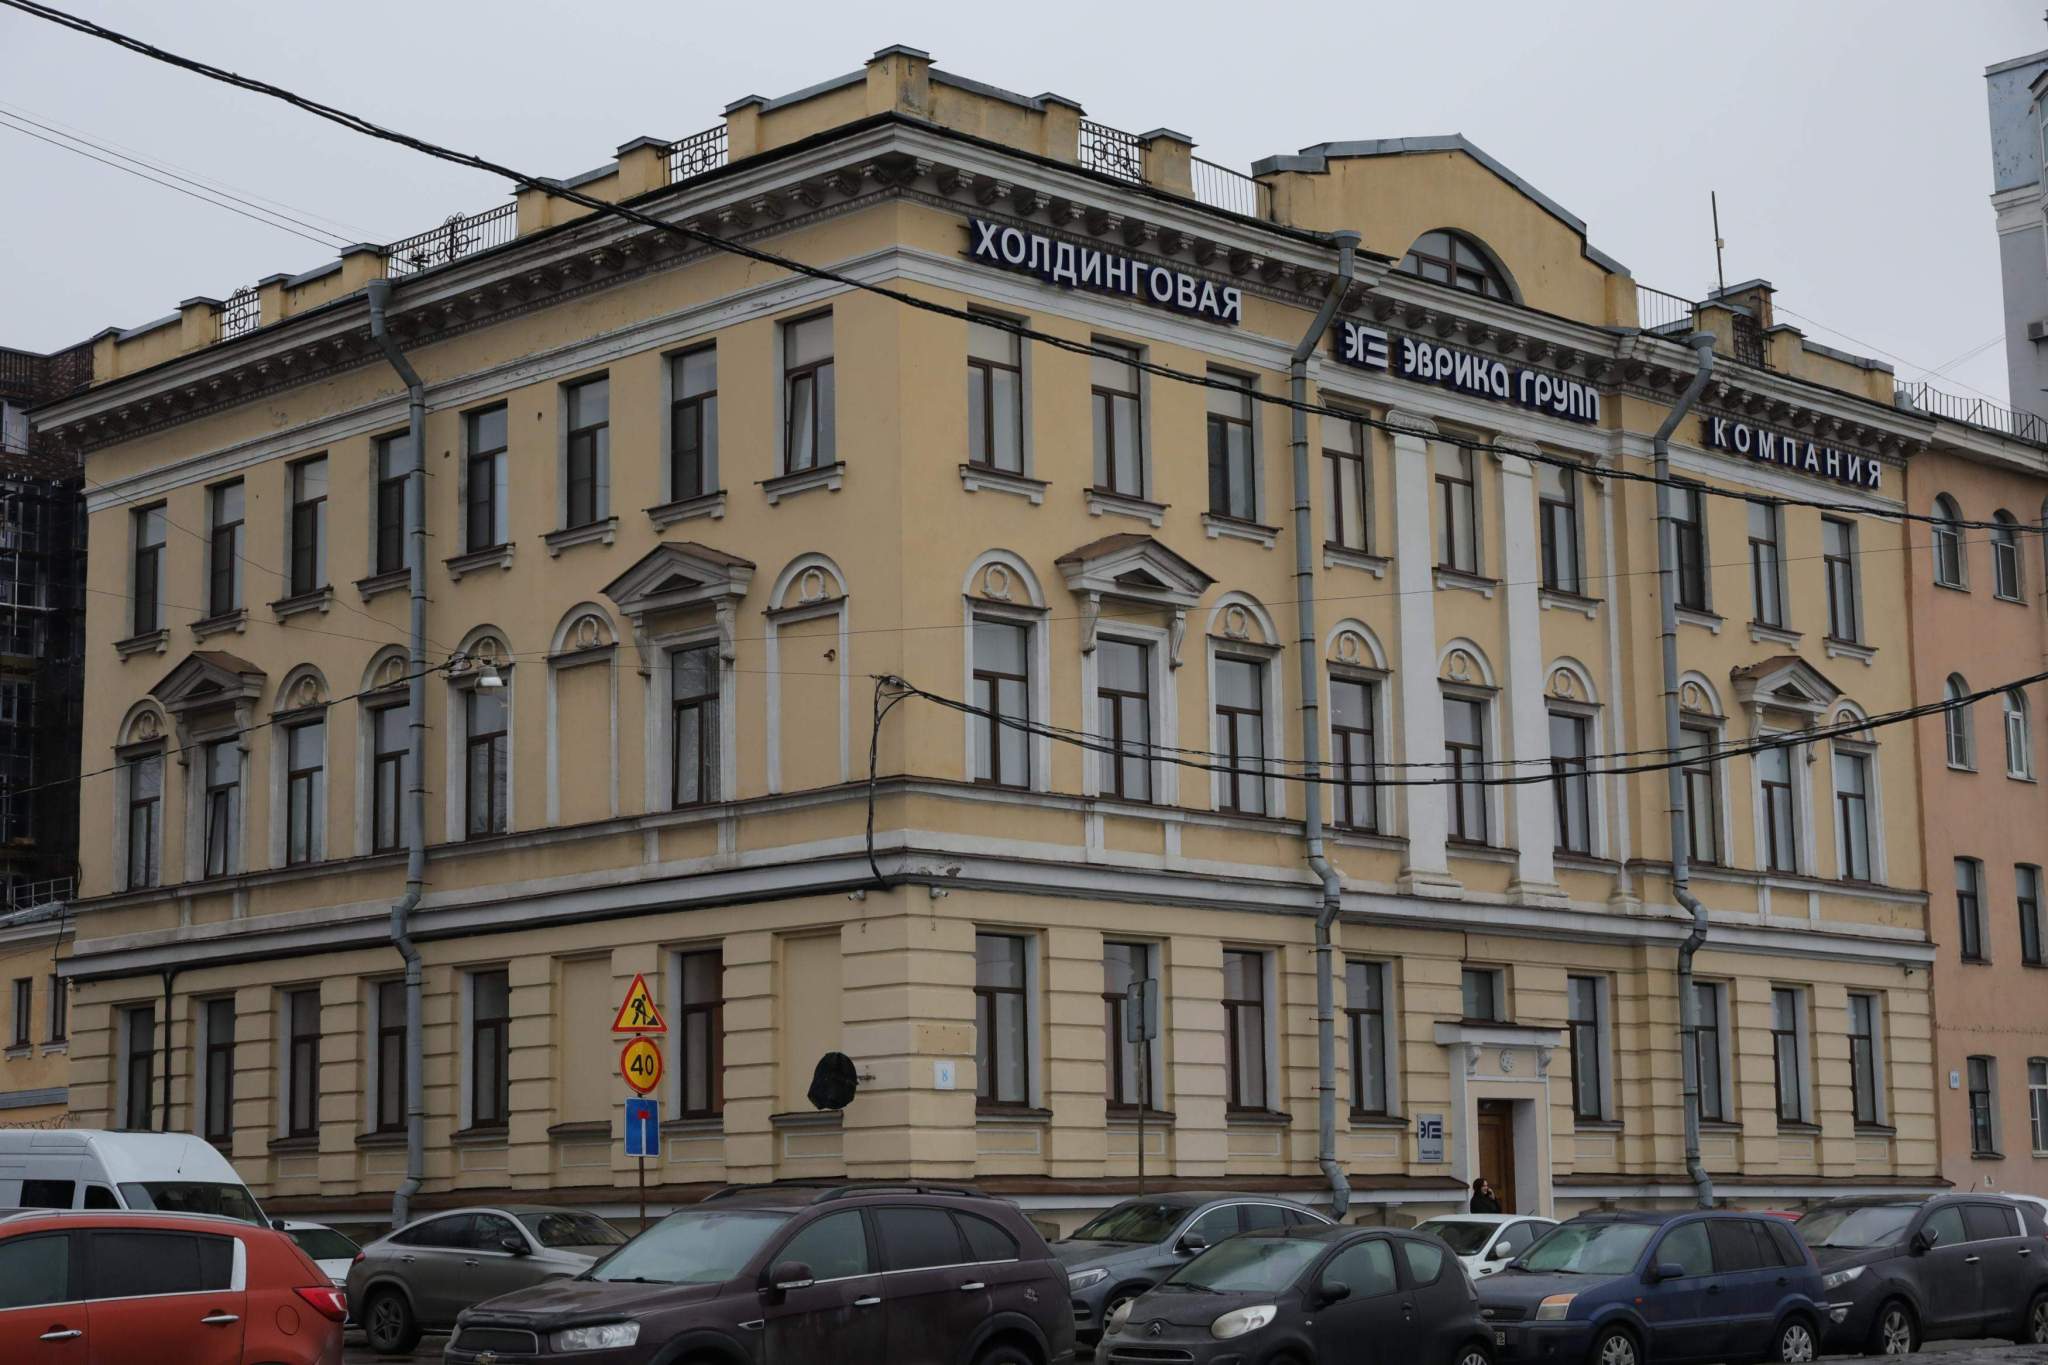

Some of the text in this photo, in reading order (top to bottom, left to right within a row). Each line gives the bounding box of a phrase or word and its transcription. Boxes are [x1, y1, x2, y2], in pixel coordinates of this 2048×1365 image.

[976, 220, 1241, 321] ХОЛДИНГОВАЯ
[1403, 337, 1600, 420] ЭВРИКА ГРУПП
[1714, 416, 1881, 488] КОМПАНИЯ
[630, 1054, 654, 1076] 40
